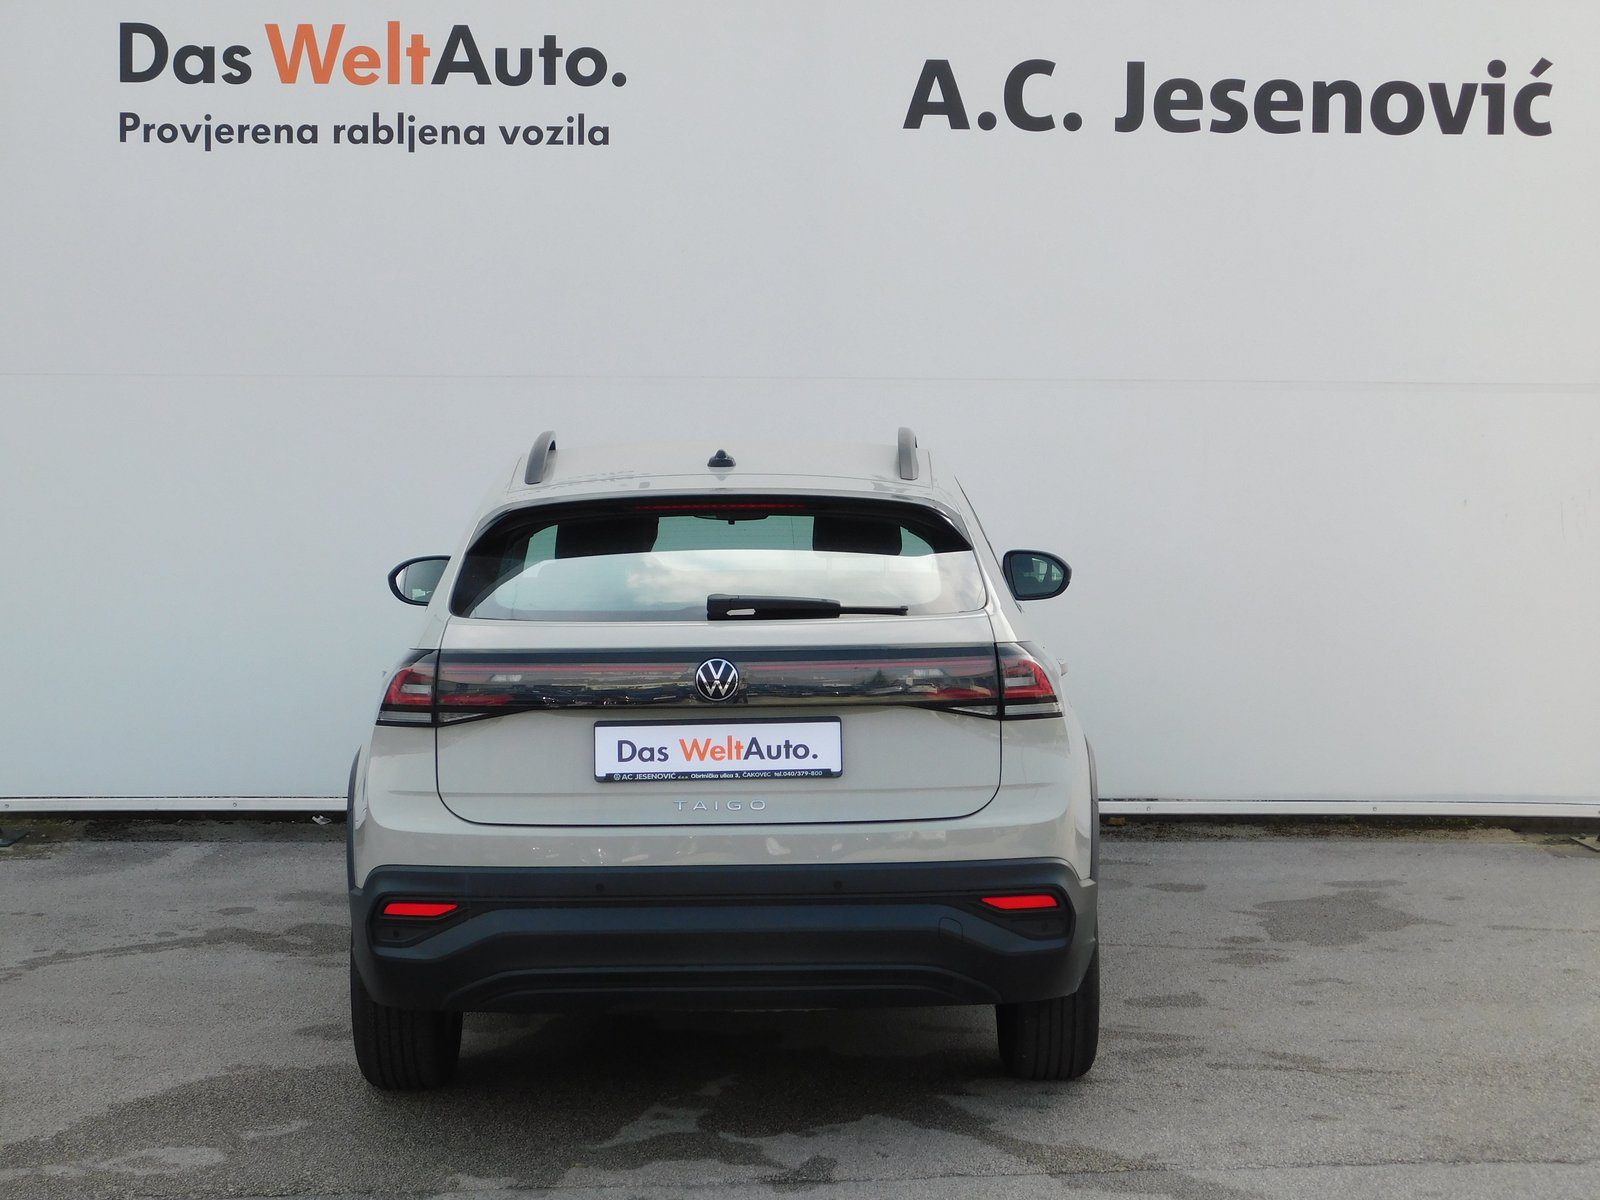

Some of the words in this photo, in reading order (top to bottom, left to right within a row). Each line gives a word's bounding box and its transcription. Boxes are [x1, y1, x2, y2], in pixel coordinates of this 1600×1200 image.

[119, 22, 253, 86] Das
[264, 21, 627, 88] WeltAuto.
[902, 58, 1083, 132] A.C.
[1114, 57, 1553, 137] Jesenović
[119, 112, 318, 152] Provjerena
[333, 111, 485, 153] rabljena
[498, 113, 610, 146] vozila
[617, 739, 670, 763] Das
[678, 735, 819, 762] WeltAuto.
[635, 772, 676, 780] JESENOVIĆ
[673, 799, 767, 812] TAIGO
